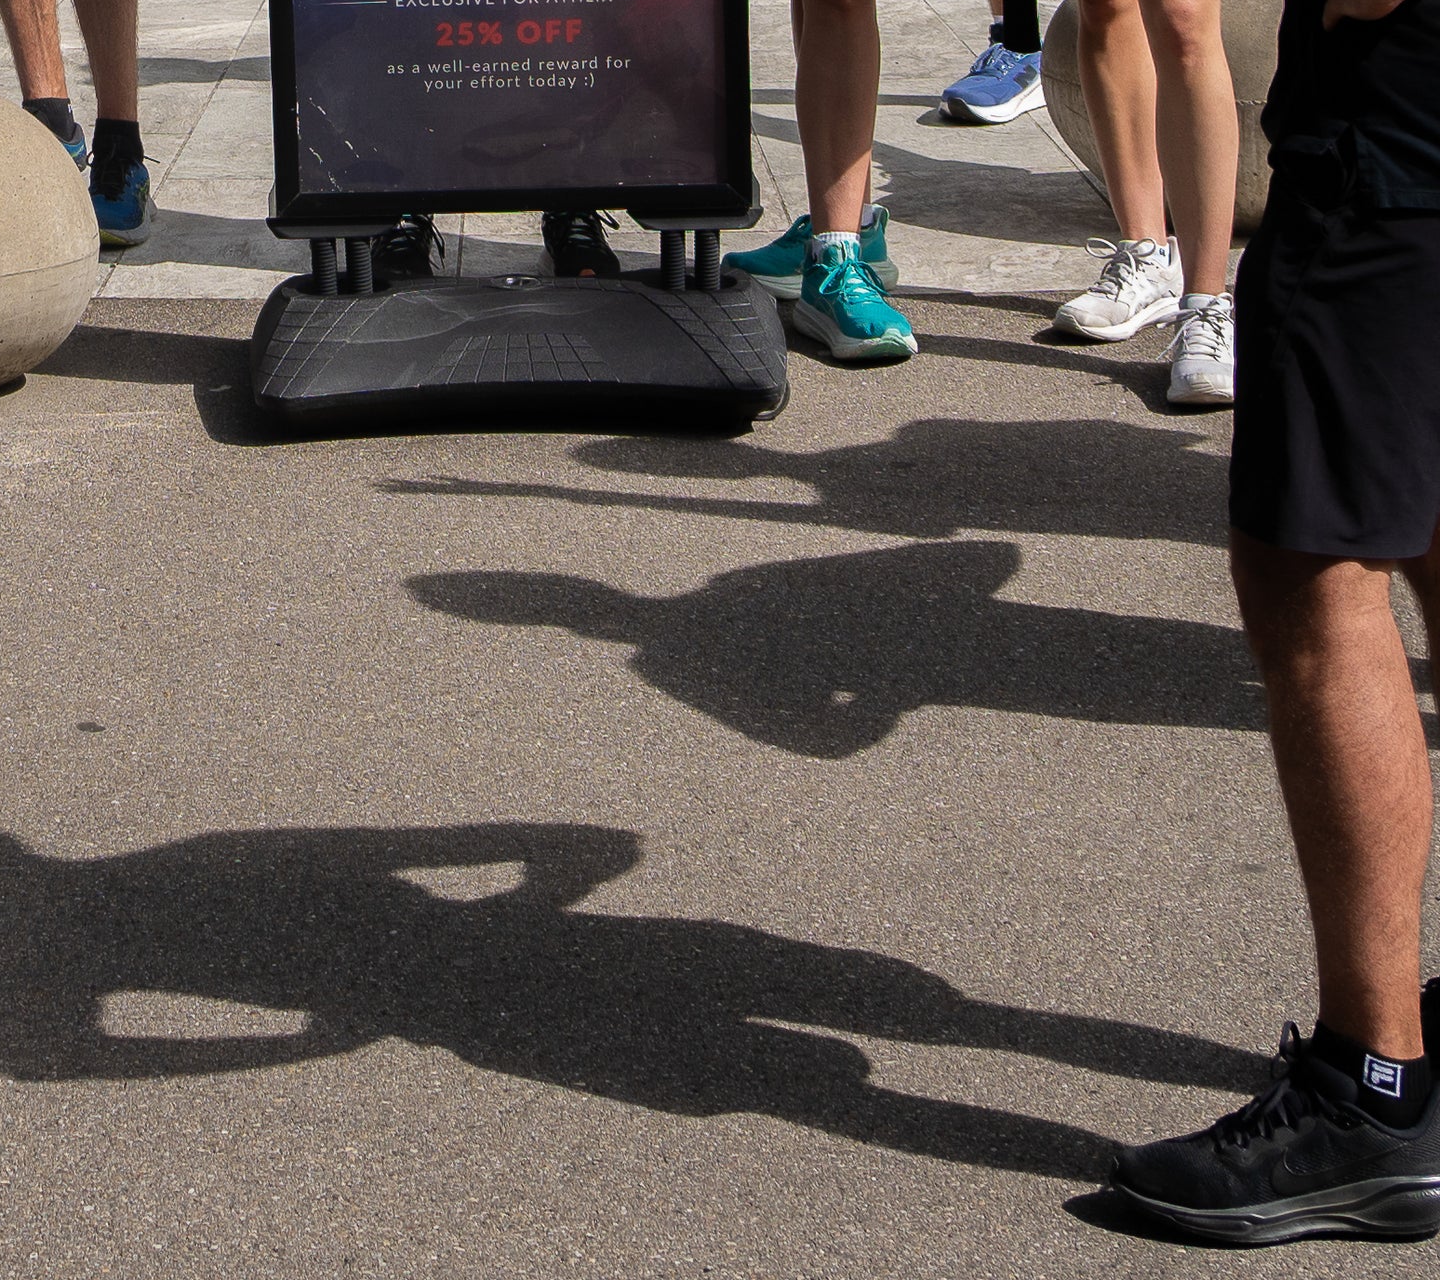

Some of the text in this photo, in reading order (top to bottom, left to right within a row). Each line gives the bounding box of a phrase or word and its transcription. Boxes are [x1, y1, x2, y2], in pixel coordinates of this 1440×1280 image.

[436, 19, 583, 47] 25% OFF
[387, 56, 631, 74] as a well-earned reward for
[424, 78, 463, 93] your
[470, 73, 521, 89] effort
[528, 73, 577, 90] today
